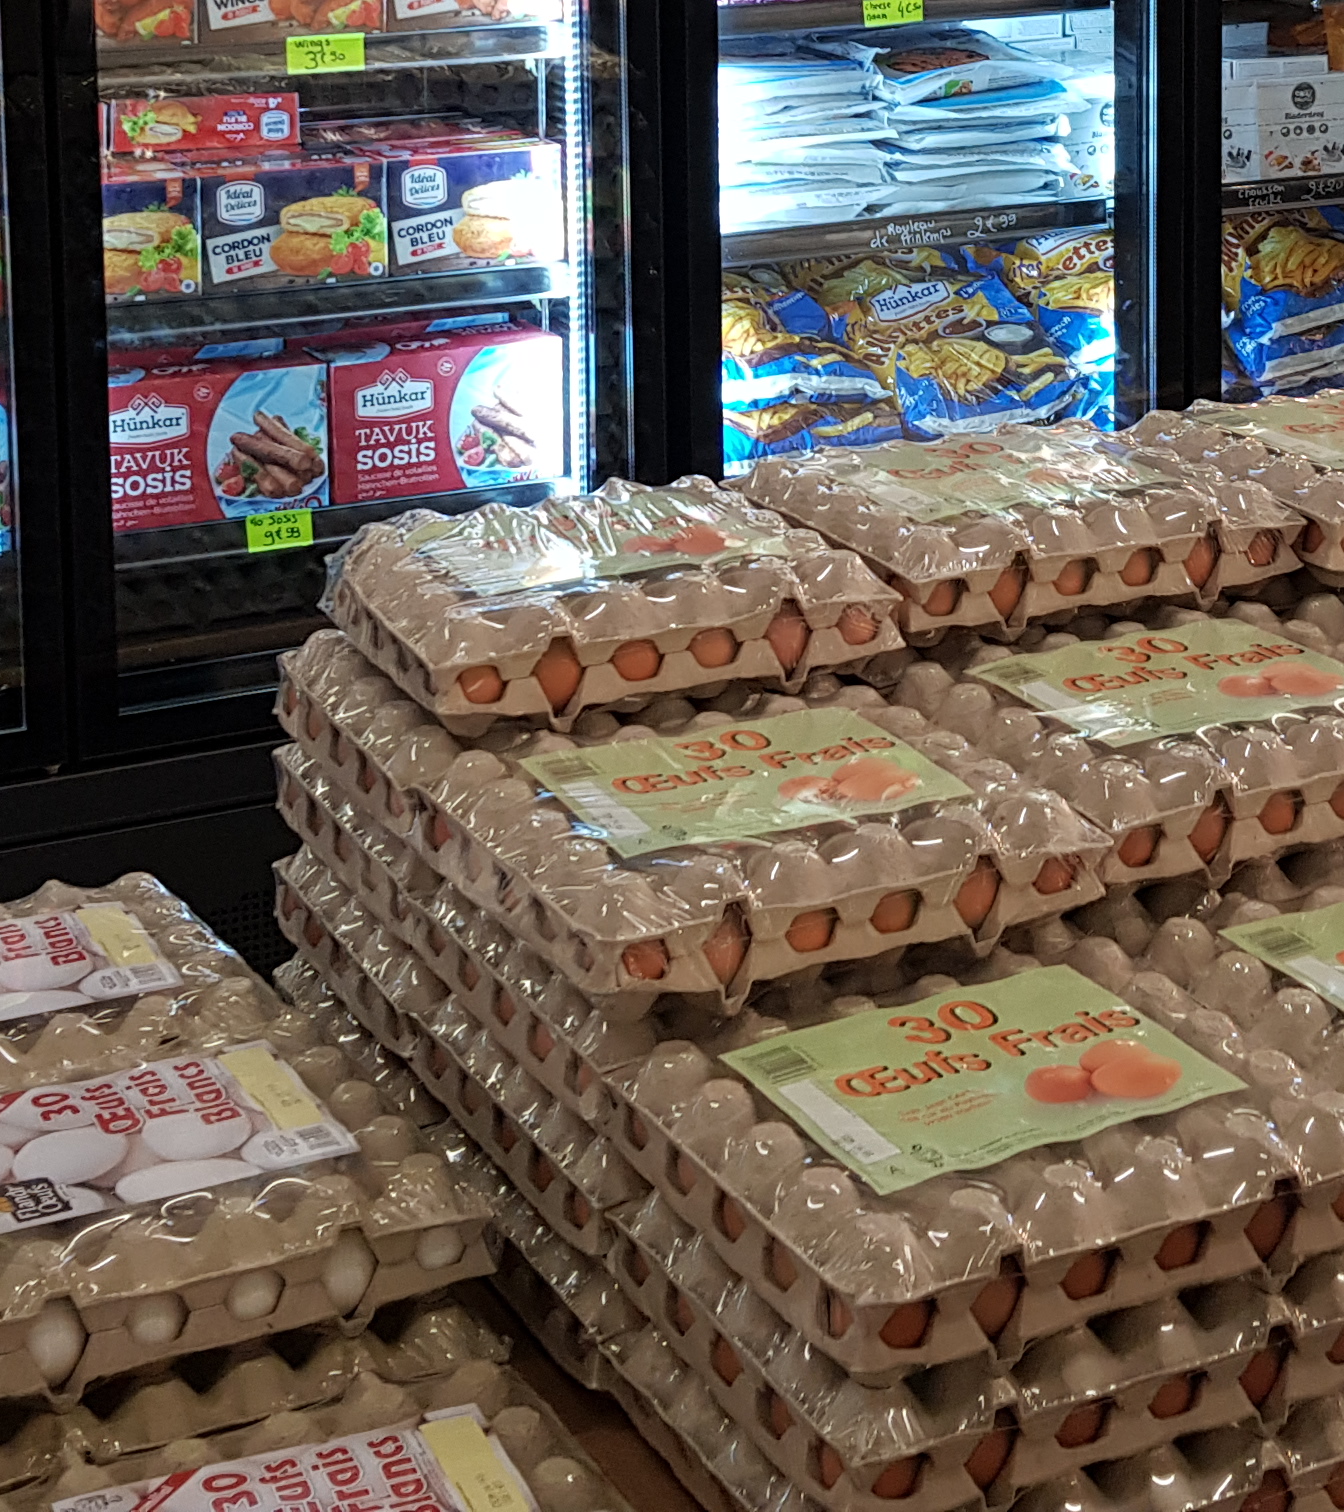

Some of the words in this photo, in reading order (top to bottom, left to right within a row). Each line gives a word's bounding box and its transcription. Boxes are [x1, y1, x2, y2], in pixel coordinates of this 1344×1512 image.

[211, 232, 272, 258] CORDON
[396, 215, 455, 241] CORDON
[410, 228, 448, 249] BLEU
[225, 245, 264, 266] BLEU
[875, 280, 944, 314] Hünkar
[361, 388, 428, 411] Hünkar
[111, 411, 185, 436] Hünkar
[355, 421, 435, 447] TAVUK
[1096, 635, 1191, 665] 30
[1062, 665, 1190, 694] Œufs
[1182, 642, 1307, 673] Frais
[672, 728, 773, 763] 30
[611, 762, 756, 795] Œufs
[756, 736, 898, 771] Frais
[33, 915, 88, 967] Blancs
[887, 998, 1000, 1045] 30
[834, 1048, 994, 1099] Œufs
[987, 1006, 1142, 1058] Frais
[29, 1092, 81, 1123] 30
[79, 1081, 143, 1136] Œufs
[127, 1068, 191, 1121] Frais
[172, 1060, 241, 1126] Blancs
